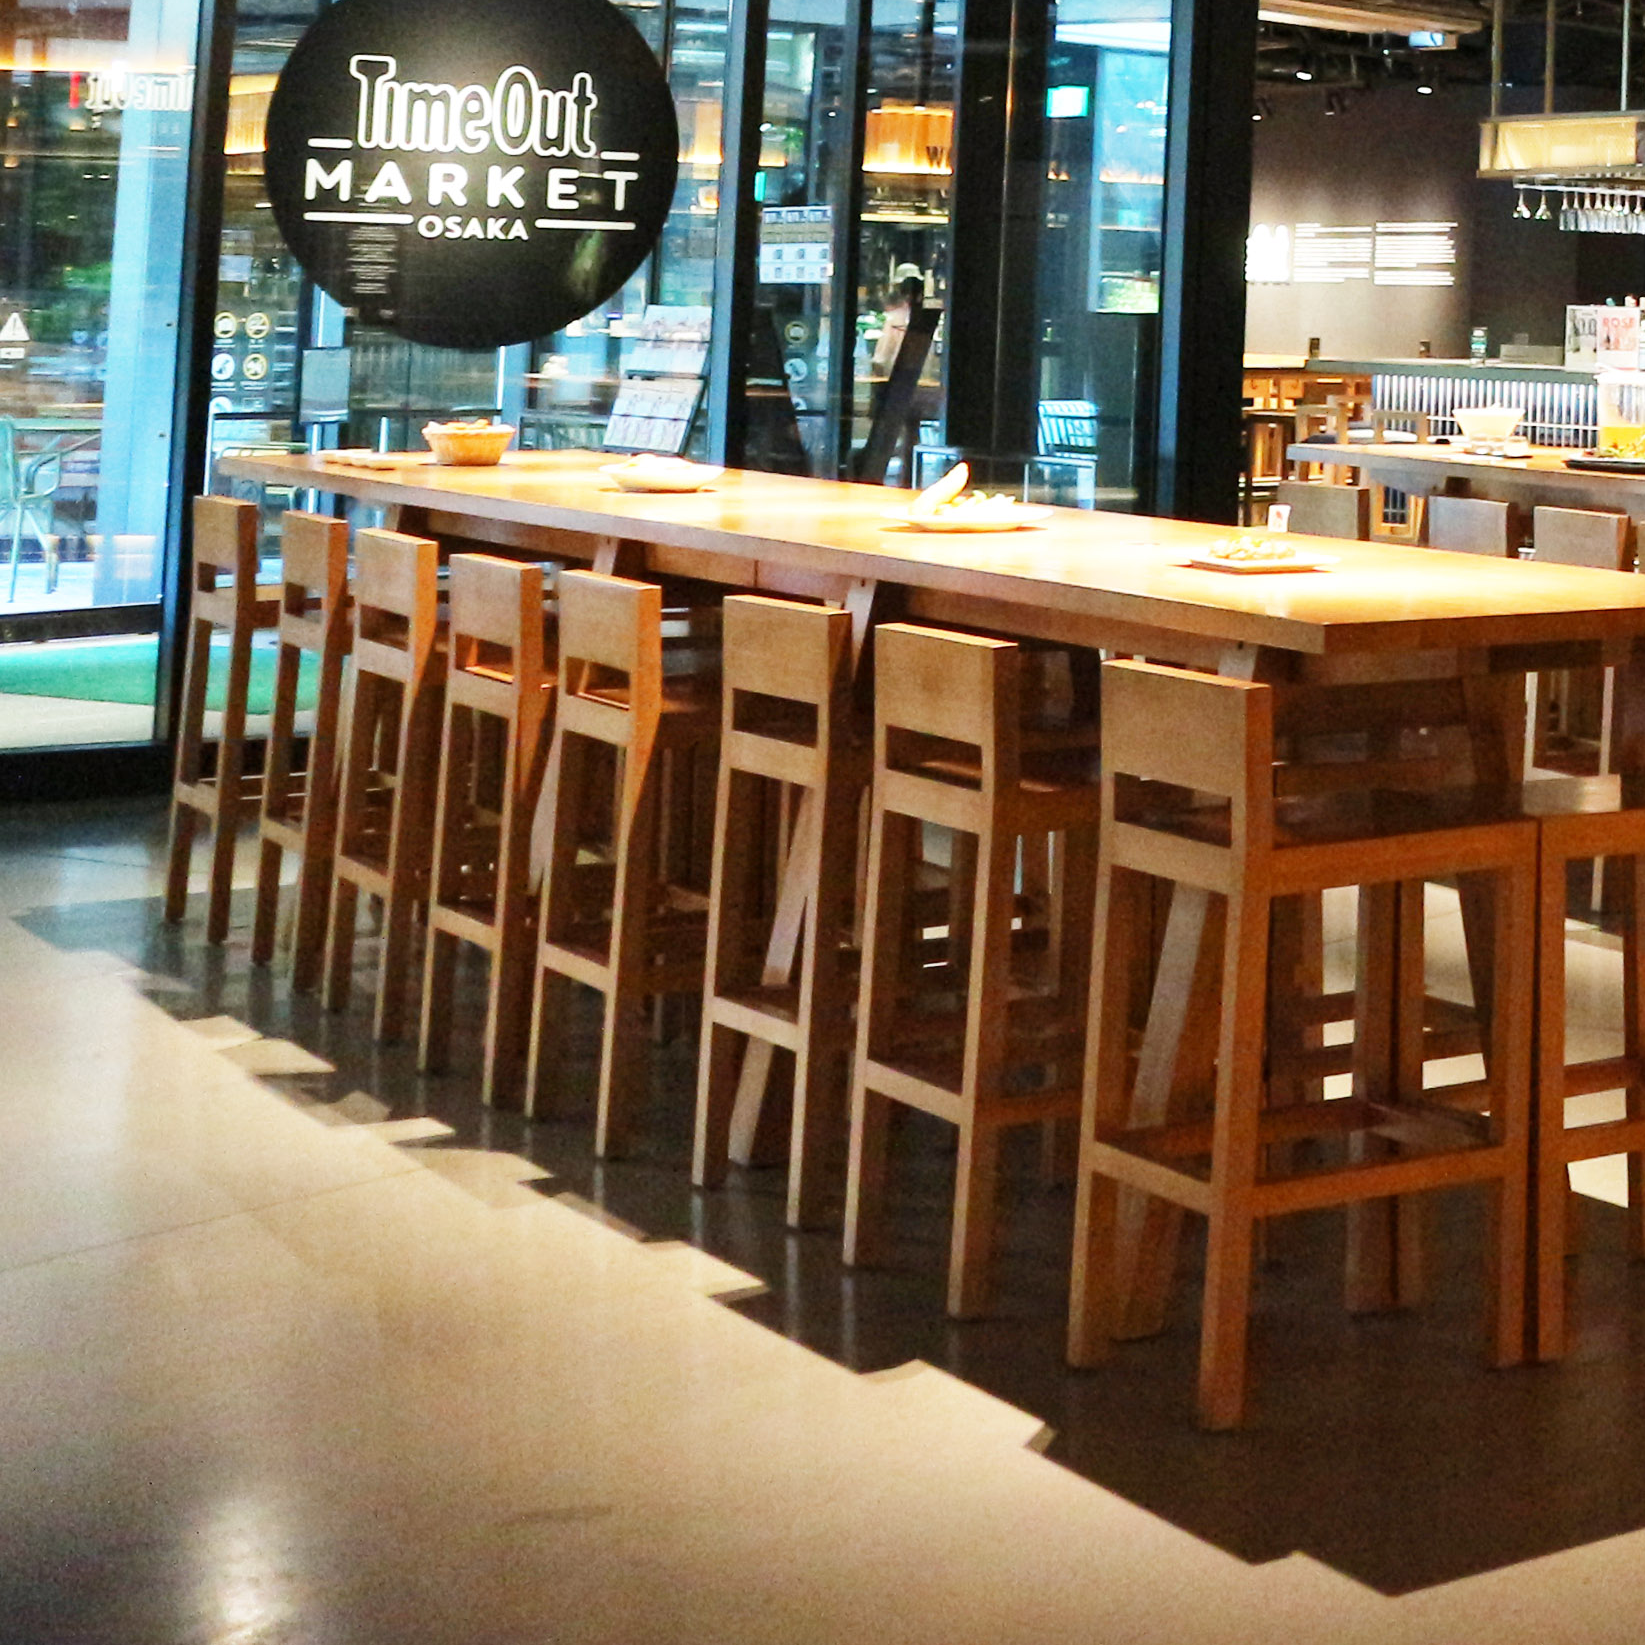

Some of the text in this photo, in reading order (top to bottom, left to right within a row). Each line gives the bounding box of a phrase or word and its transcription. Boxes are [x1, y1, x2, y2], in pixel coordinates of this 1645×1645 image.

[349, 54, 598, 158] Time Out
[304, 158, 639, 212] MARKET
[417, 213, 529, 241] OSAKA
